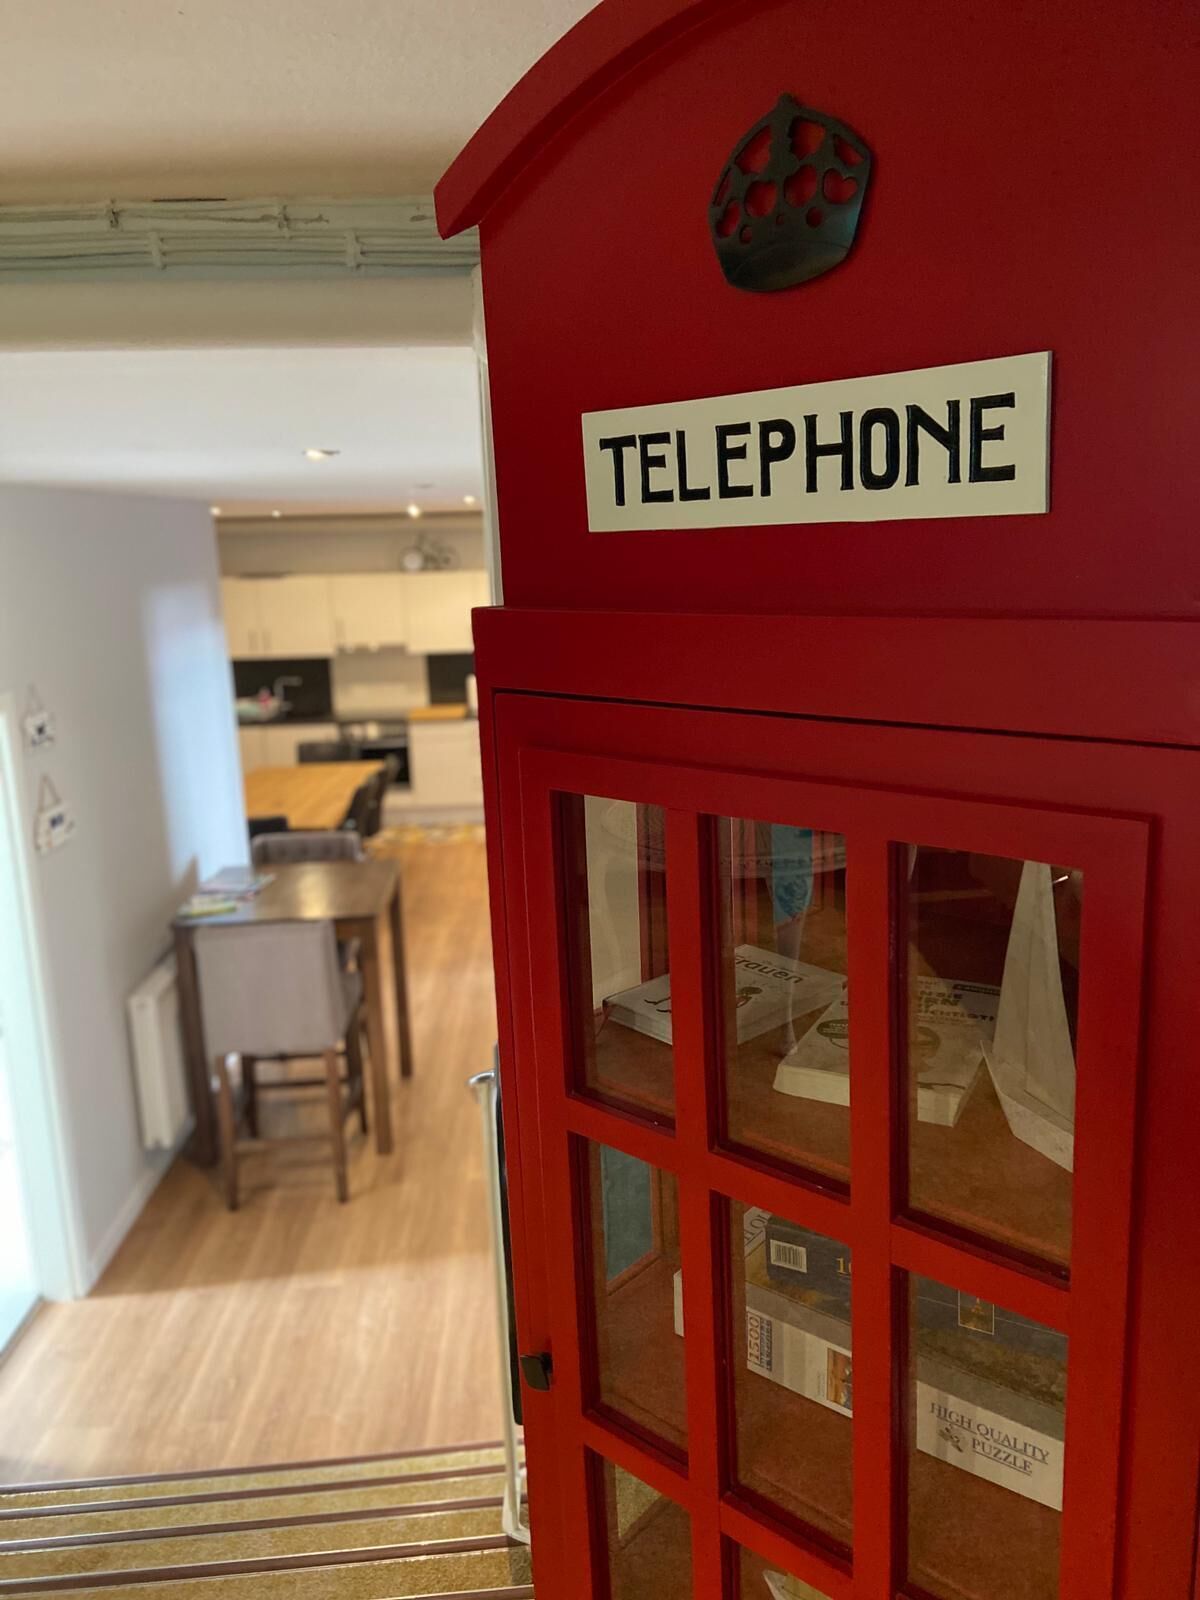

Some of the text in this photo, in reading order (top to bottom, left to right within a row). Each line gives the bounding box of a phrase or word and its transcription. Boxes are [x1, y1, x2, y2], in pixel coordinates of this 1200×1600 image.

[599, 391, 1016, 507] TELEPHONE
[835, 1257, 852, 1275] 1
[749, 1315, 760, 1361] 1500
[930, 1402, 1050, 1461] HIGH QUALITY
[971, 1437, 1033, 1474] PUZZLE
